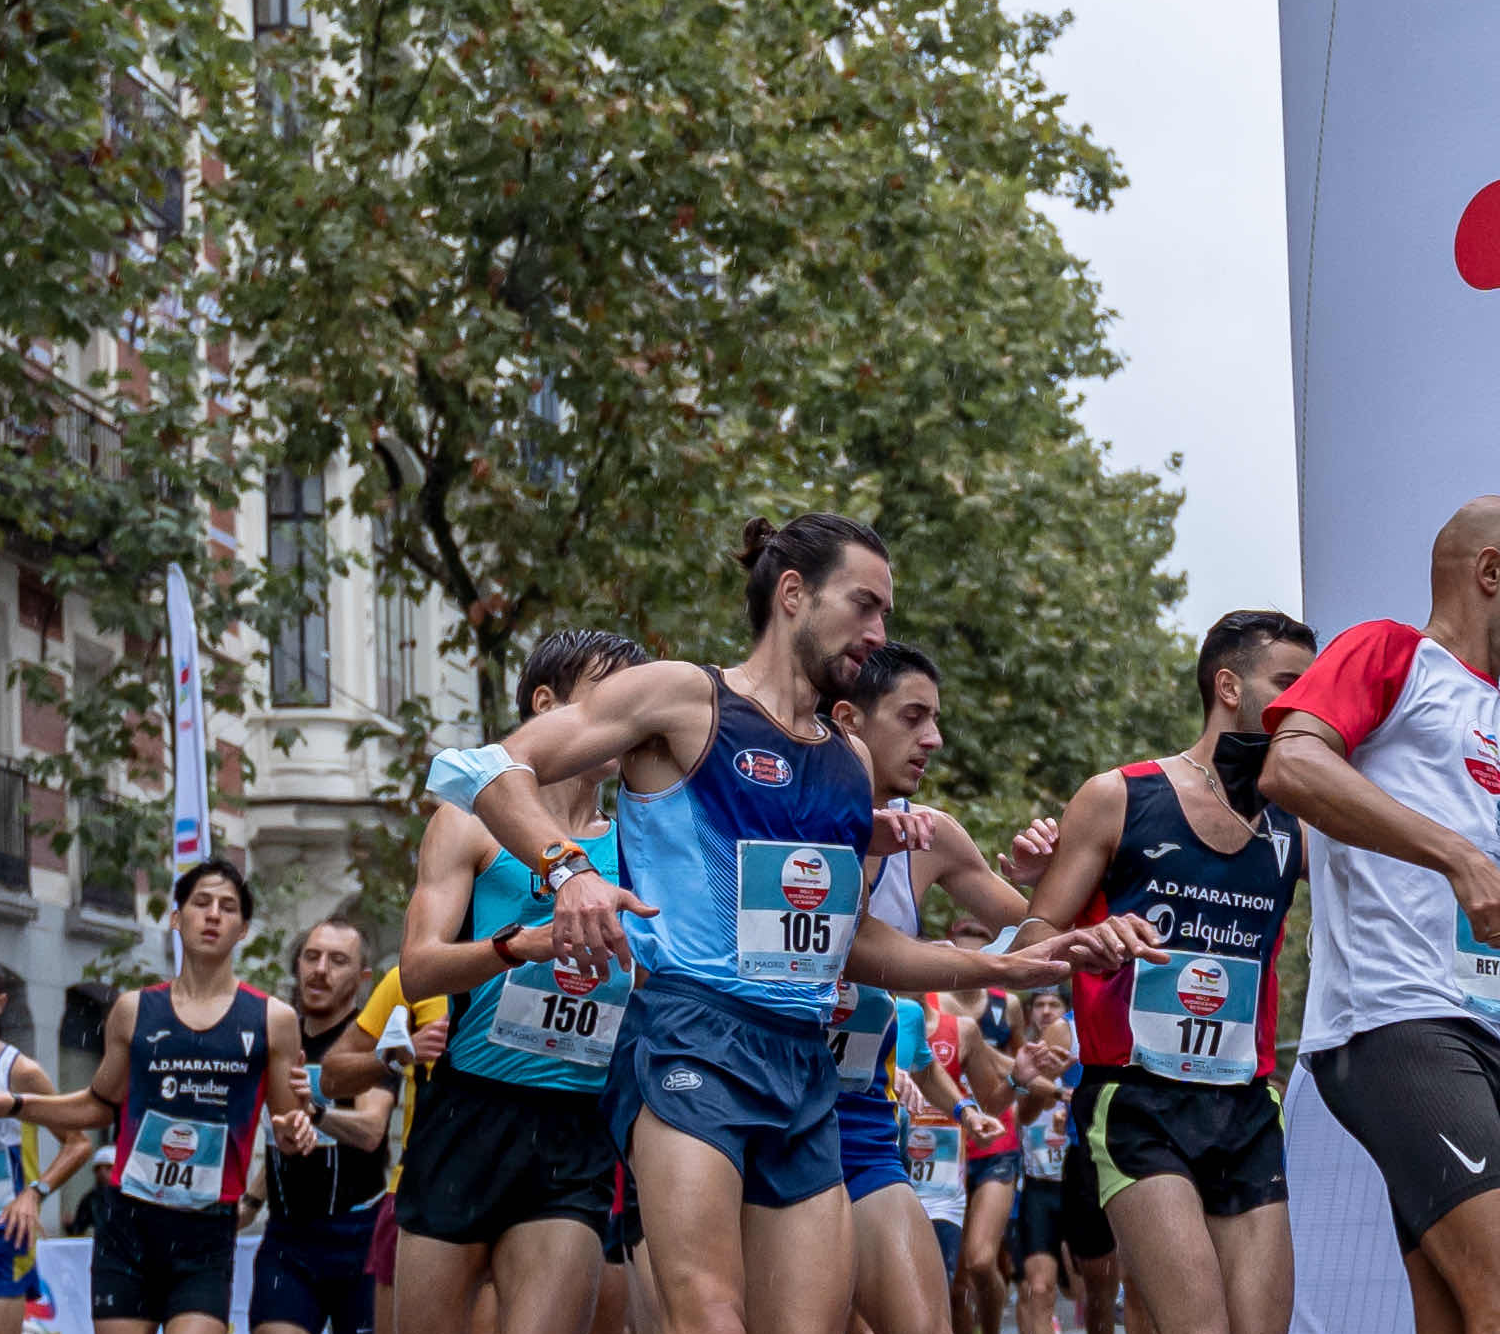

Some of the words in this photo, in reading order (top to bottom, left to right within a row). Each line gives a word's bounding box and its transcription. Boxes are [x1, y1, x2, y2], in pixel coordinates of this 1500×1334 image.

[1146, 879, 1275, 913] A.D.MARATHON
[779, 911, 831, 955] 105
[1180, 913, 1262, 952] alquiber
[541, 994, 599, 1037] 150
[1176, 1017, 1224, 1056] 177
[148, 1058, 250, 1074] A.D.MARATHON
[179, 1077, 230, 1102] alquiber
[154, 1161, 194, 1190] 104
